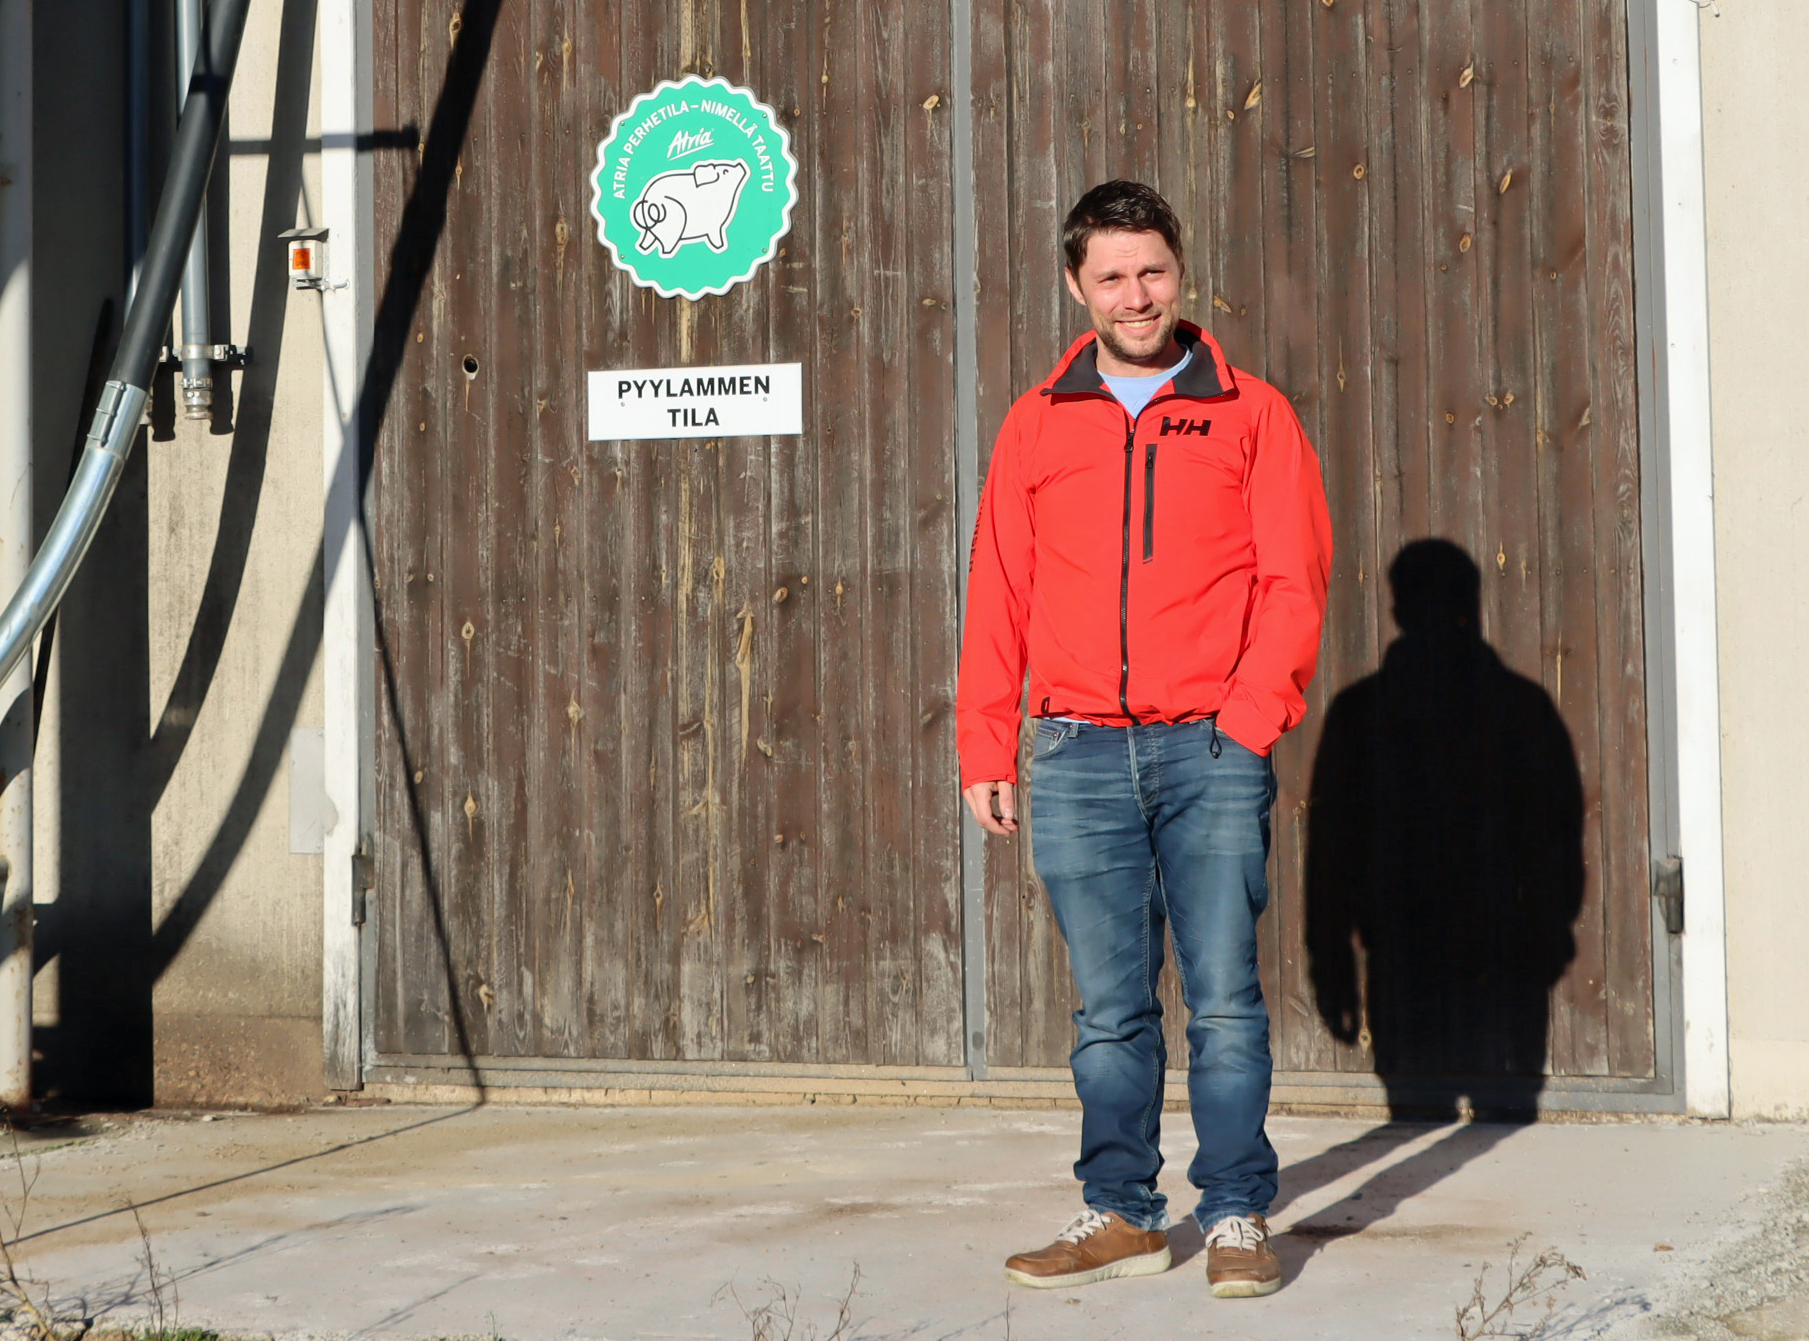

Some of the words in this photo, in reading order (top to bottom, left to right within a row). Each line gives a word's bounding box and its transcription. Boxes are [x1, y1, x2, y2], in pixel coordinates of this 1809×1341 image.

[666, 127, 715, 158] Atria
[613, 157, 631, 199] ATRIA
[752, 135, 774, 192] TAATTU
[617, 375, 771, 399] PYYLAMMEN
[667, 407, 720, 427] TILA
